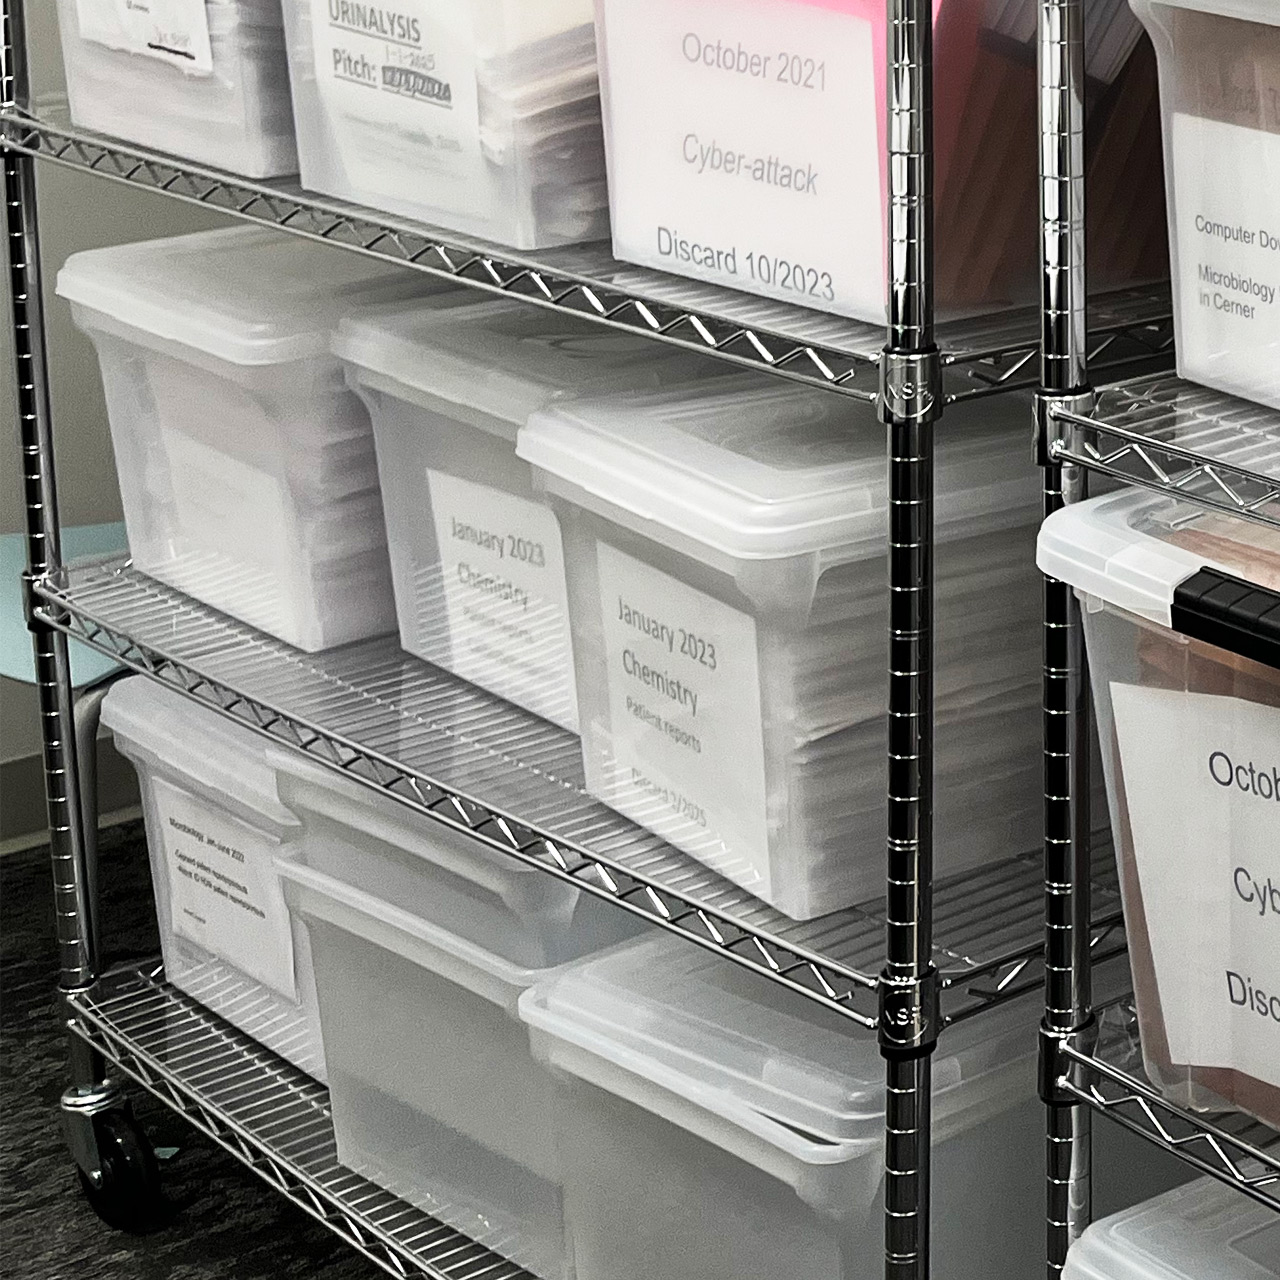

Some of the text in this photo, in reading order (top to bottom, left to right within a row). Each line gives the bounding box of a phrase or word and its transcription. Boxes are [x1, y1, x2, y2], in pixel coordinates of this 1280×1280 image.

[333, 48, 376, 82] Pitch:
[682, 32, 825, 91] October 2021
[683, 134, 818, 195] Cyber-attack
[1195, 215, 1255, 245] Computer
[657, 226, 835, 302] Discard 10/2023
[1198, 264, 1275, 304] Microbiology
[1213, 292, 1255, 320] Cerner
[452, 517, 505, 559] January
[618, 596, 717, 671] January 2023
[622, 649, 698, 717] Chemistry
[626, 695, 702, 753] Patient reports
